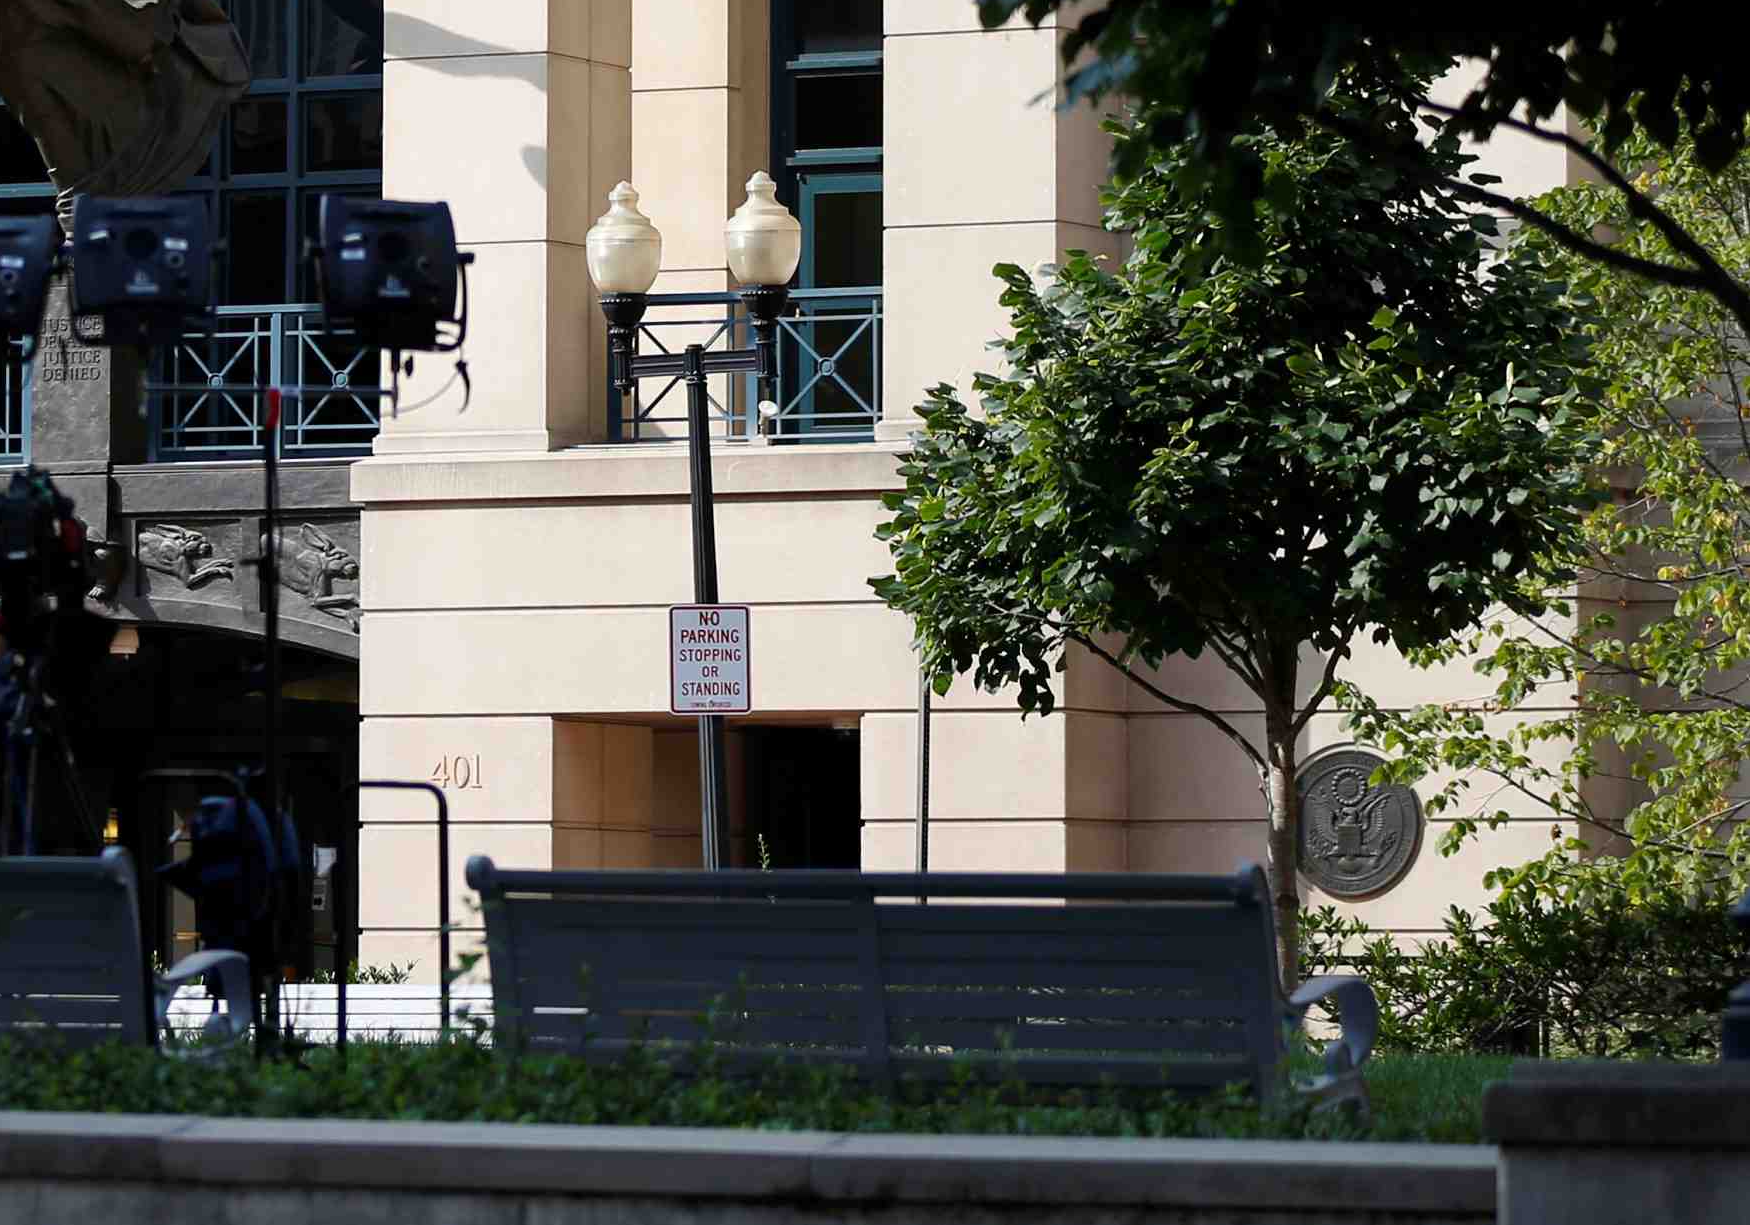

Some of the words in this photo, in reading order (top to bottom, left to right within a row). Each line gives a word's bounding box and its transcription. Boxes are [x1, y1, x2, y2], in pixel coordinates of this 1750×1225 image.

[42, 316, 102, 334] JUSICE
[699, 611, 720, 626] NO
[681, 629, 739, 644] PARKING
[679, 648, 742, 662] STOPPING
[702, 665, 719, 678] OR
[681, 682, 741, 696] STANDING
[430, 754, 483, 789] 401
